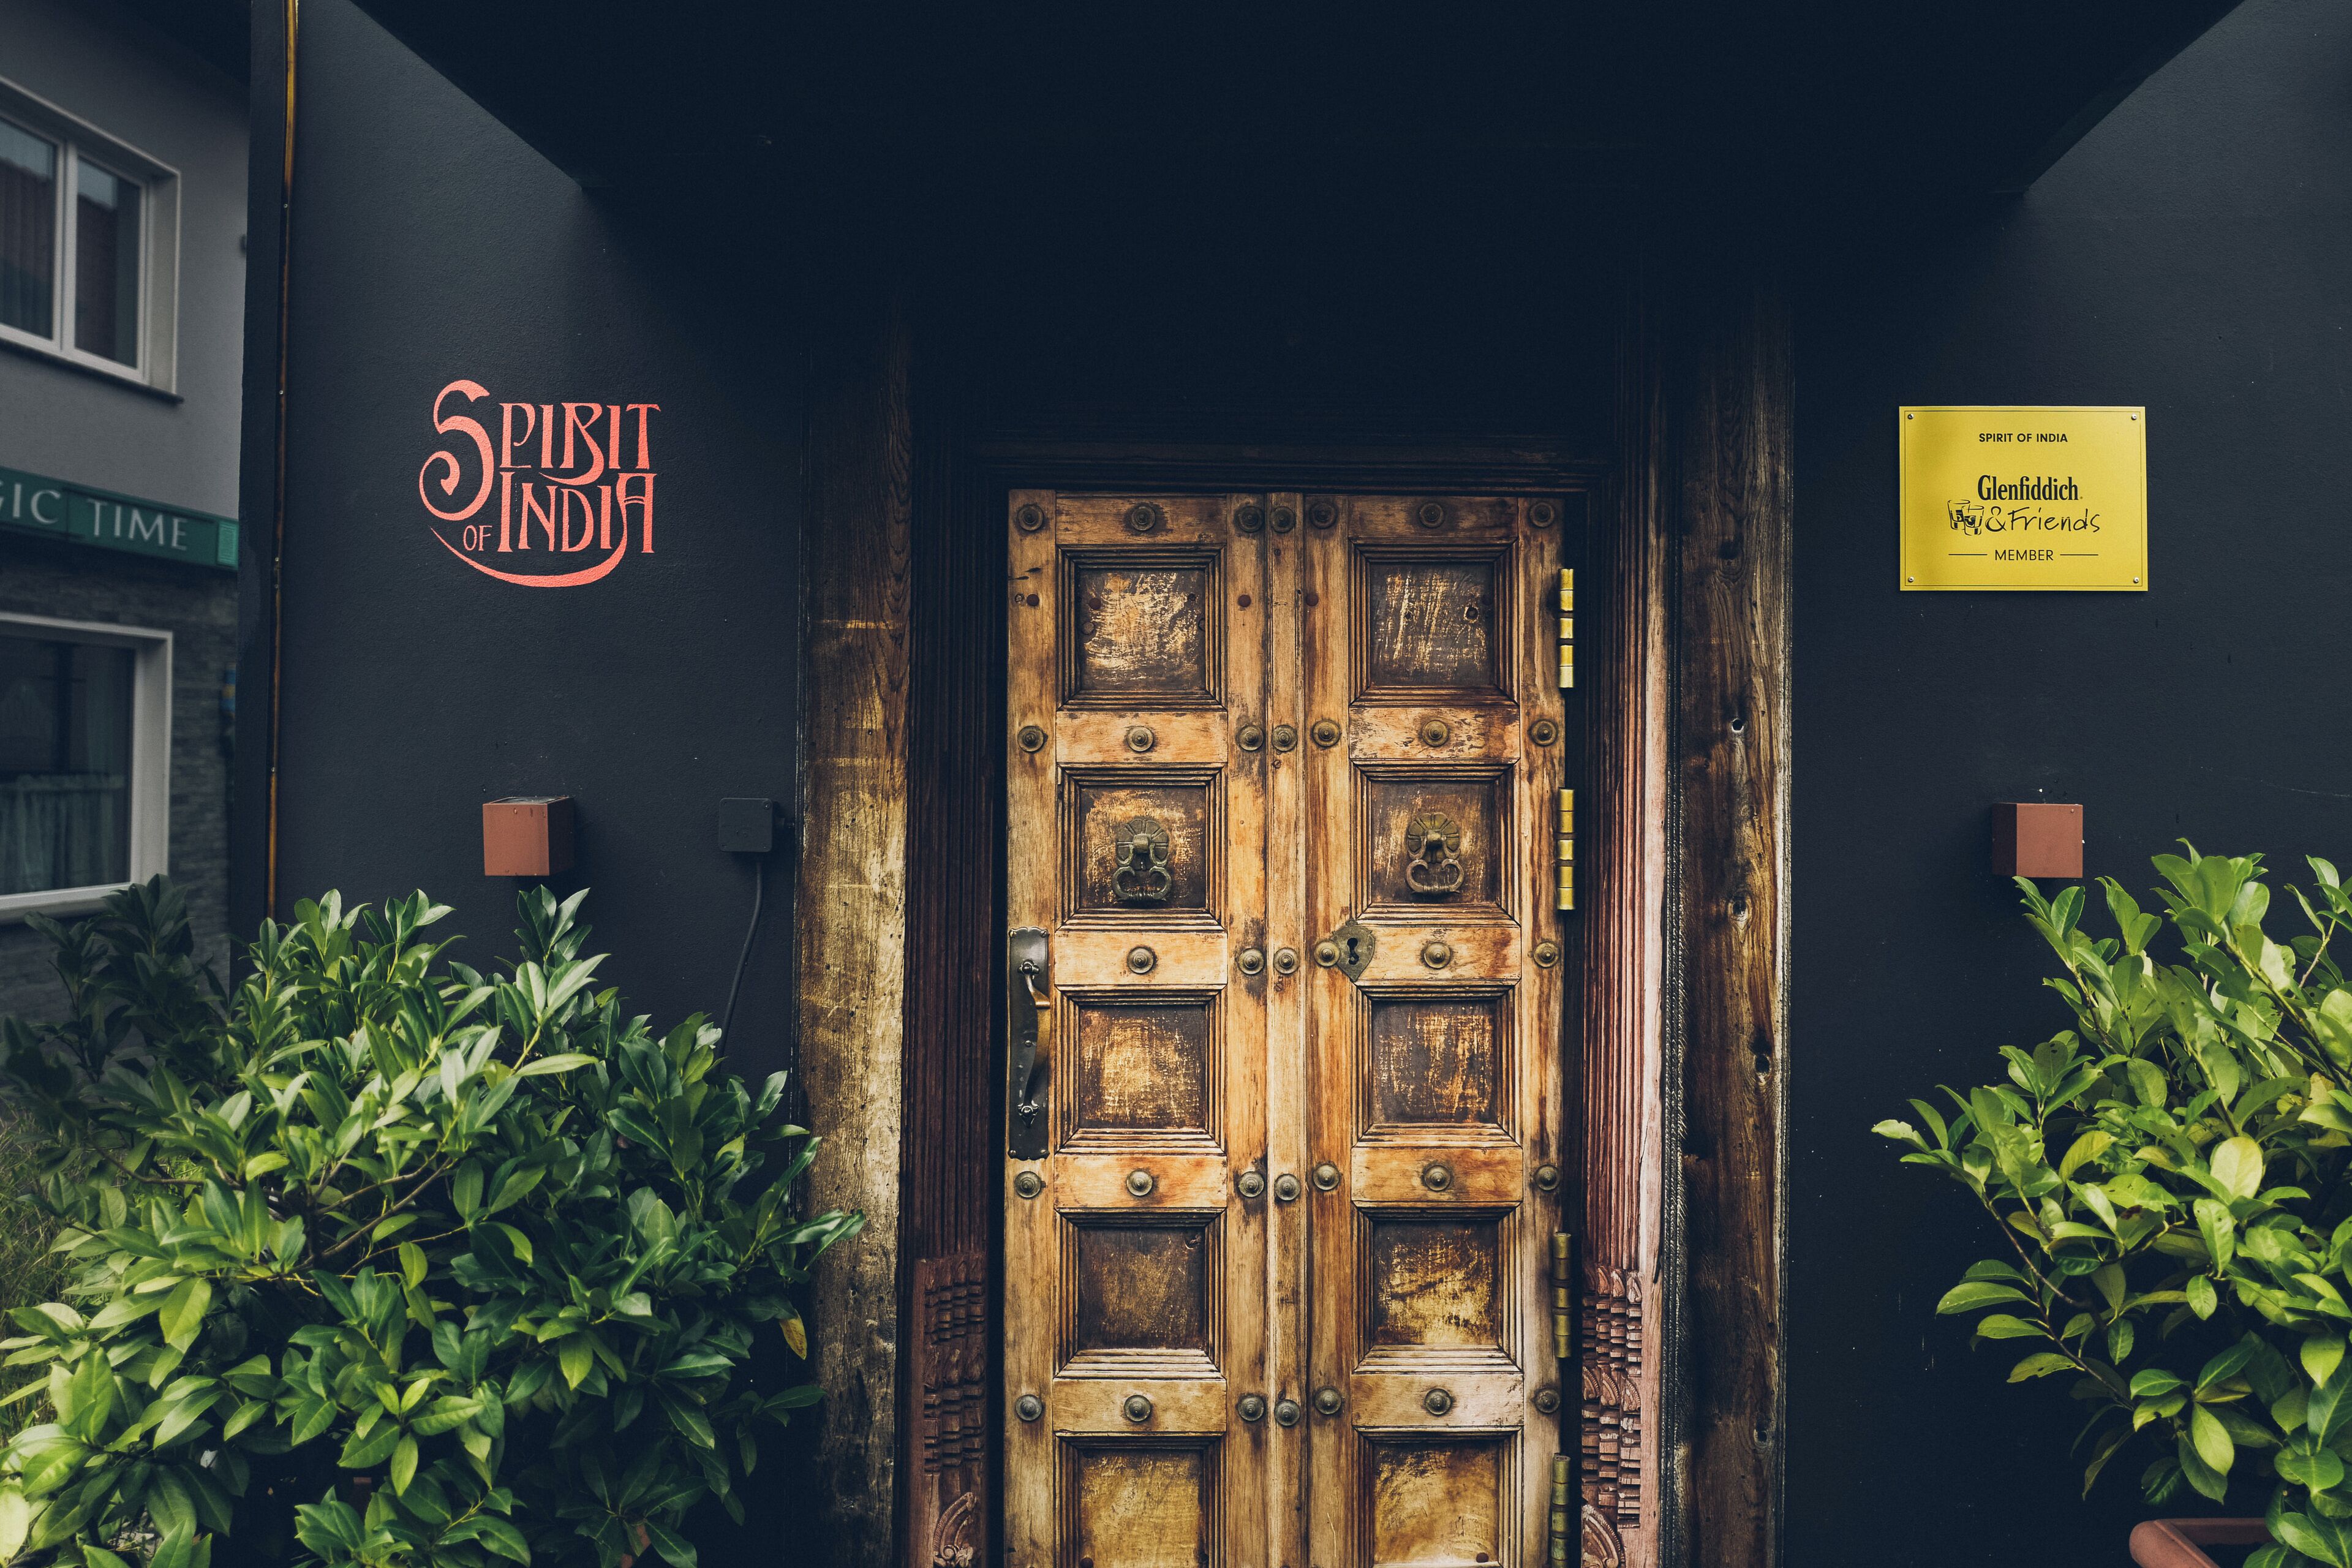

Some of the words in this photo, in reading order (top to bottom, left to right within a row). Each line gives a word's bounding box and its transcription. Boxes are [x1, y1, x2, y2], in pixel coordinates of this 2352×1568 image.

[419, 380, 662, 521] SPIRIT
[1979, 433, 2013, 443] SPIRIT
[2017, 433, 2033, 443] OF
[2036, 433, 2068, 443] INDIA
[1978, 474, 2079, 501] Glenfiddich
[0, 481, 61, 524] IC
[88, 498, 188, 551] TIME
[463, 525, 492, 551] OF
[497, 472, 657, 587] INDIA
[1994, 549, 2054, 561] MEMBER
